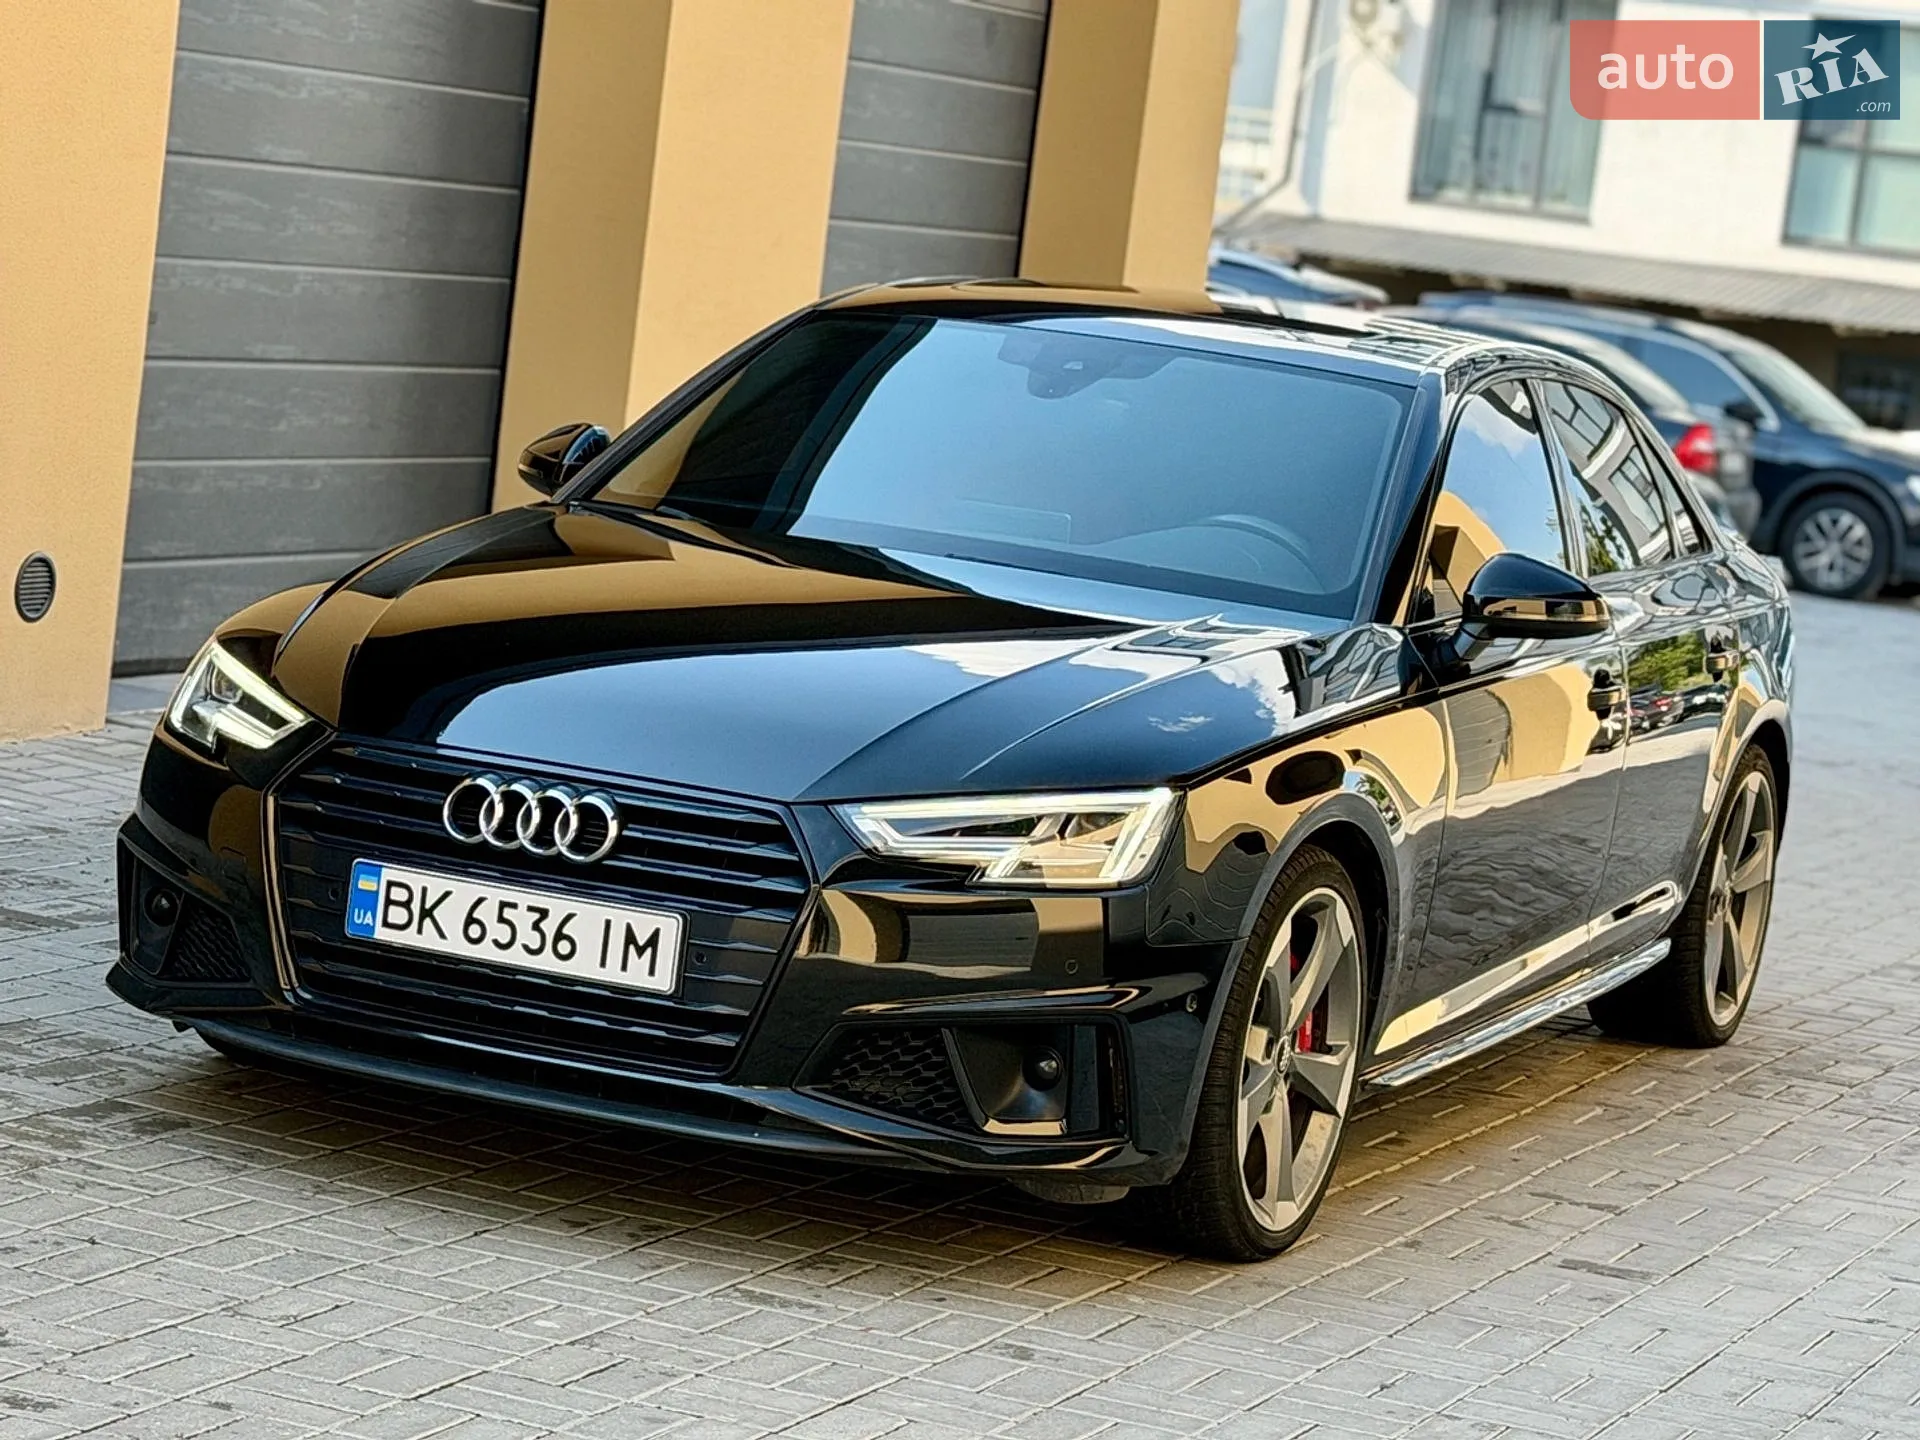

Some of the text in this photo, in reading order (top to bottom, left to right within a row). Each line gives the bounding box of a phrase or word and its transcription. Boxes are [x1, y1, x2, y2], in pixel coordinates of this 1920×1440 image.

[353, 910, 374, 927] UA
[381, 879, 661, 977] BK 6536 IM
